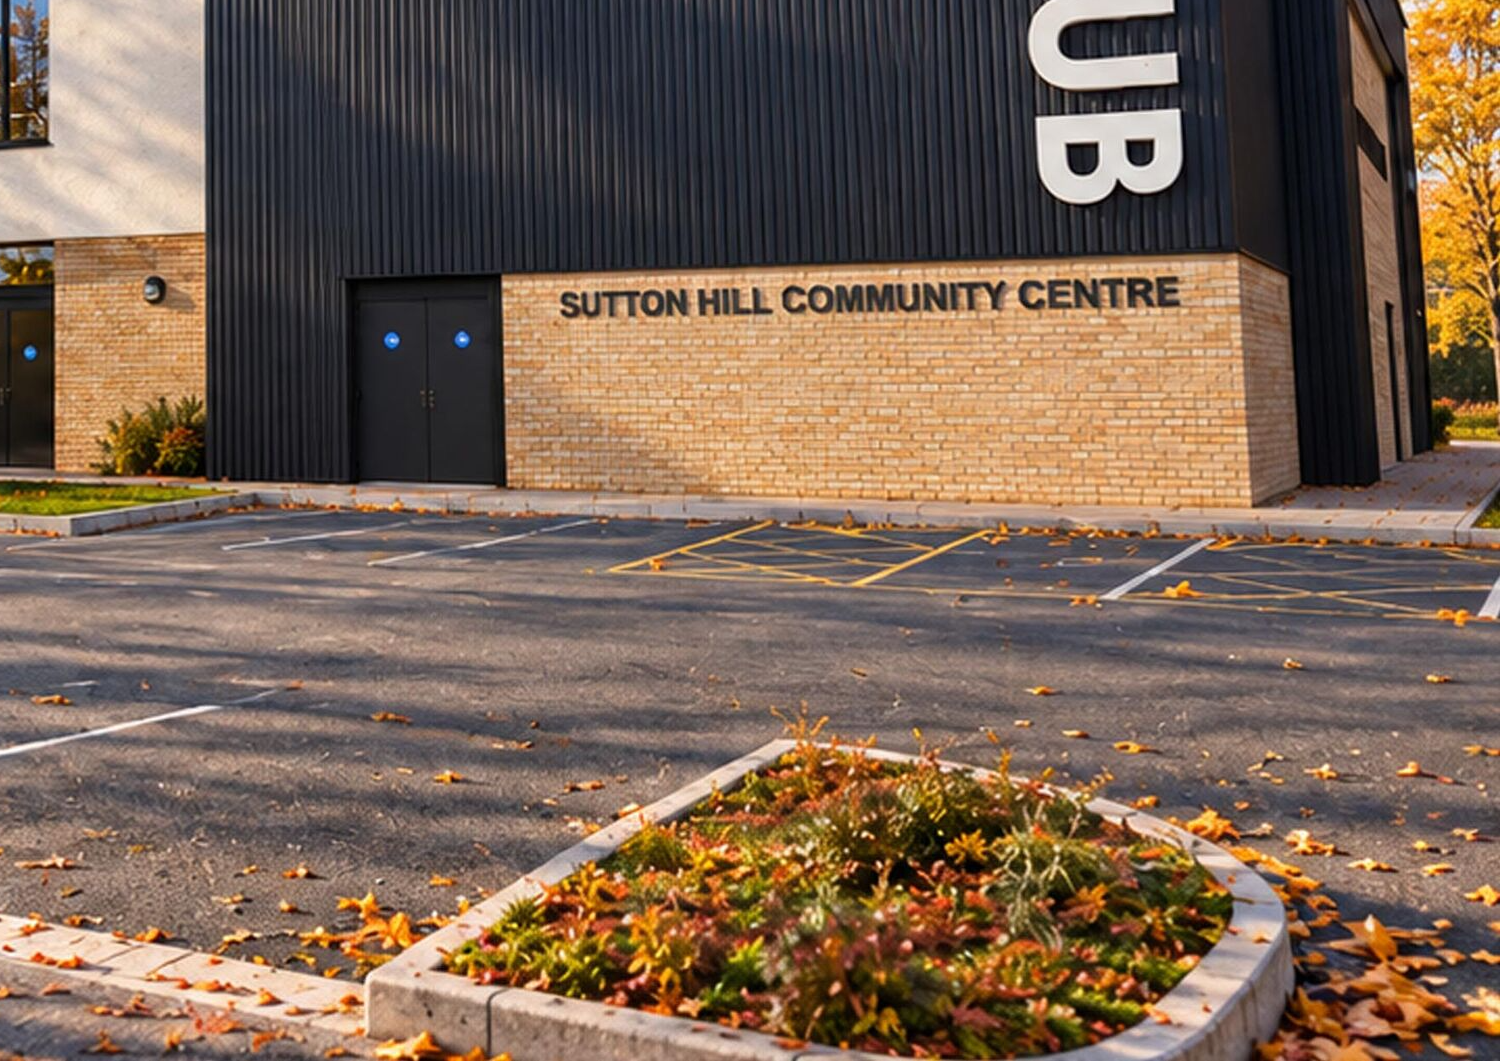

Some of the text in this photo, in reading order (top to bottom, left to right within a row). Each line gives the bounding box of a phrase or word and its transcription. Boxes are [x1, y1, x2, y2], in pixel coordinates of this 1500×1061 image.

[560, 276, 1181, 319] SUTTON HILL COMMUNITY CENTRE
